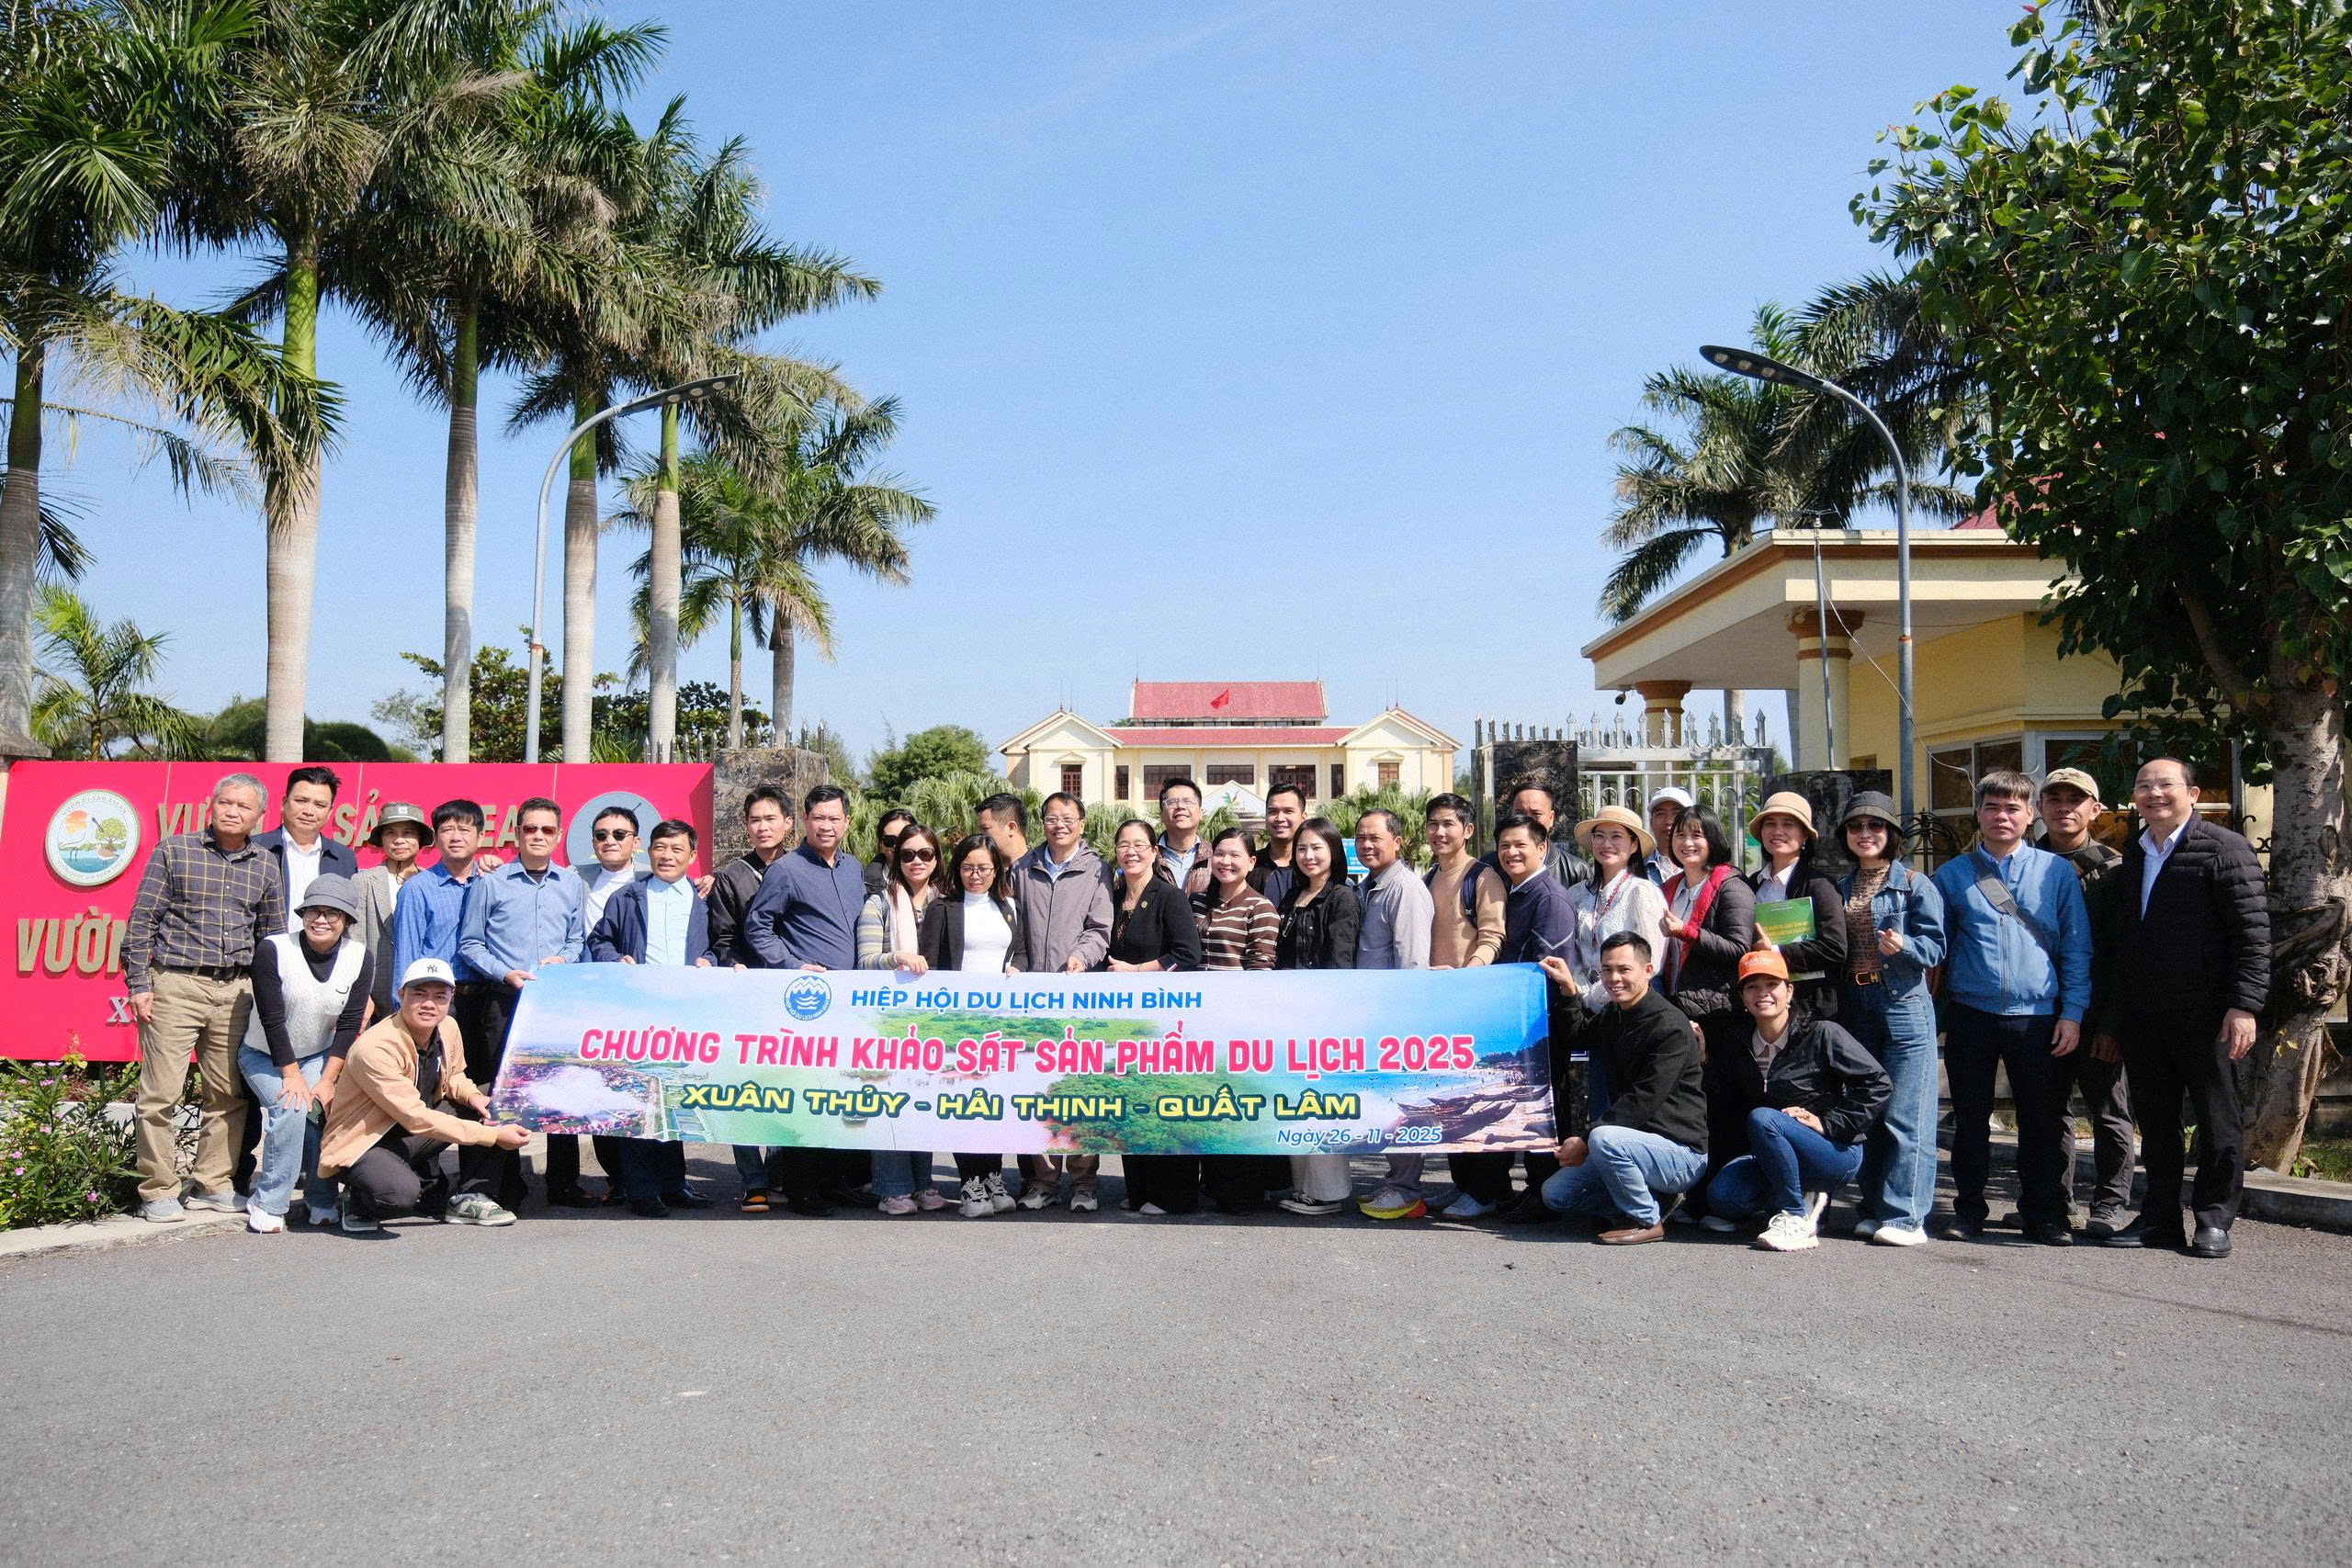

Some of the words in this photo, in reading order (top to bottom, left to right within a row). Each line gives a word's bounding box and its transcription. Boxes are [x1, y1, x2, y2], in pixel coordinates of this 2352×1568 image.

[852, 987, 908, 1010] HIỆP
[916, 987, 958, 1013] HỘI
[967, 992, 1001, 1009] DU
[1011, 992, 1064, 1013] LỊCH
[1073, 992, 1133, 1009] NINH
[1141, 987, 1202, 1009] BÌNH
[580, 1025, 720, 1064] CHƯƠNG
[735, 1027, 839, 1067] TRÌNH
[851, 1024, 944, 1071] KHẢO
[956, 1032, 1024, 1073] SÁT
[1035, 1026, 1103, 1073] SẢN
[1117, 1020, 1215, 1073] PHẨM
[1227, 1039, 1273, 1072] DU
[1287, 1037, 1364, 1079] LỊCH
[1378, 1035, 1475, 1070] 2025
[683, 1082, 791, 1111] XUÂN
[805, 1087, 905, 1114] THỦY
[938, 1089, 1001, 1117] HẢI
[1012, 1097, 1123, 1121] THỊNH
[1158, 1087, 1262, 1117] QUẤT
[1276, 1090, 1357, 1117] LÂM
[1277, 1129, 1327, 1145] Ngày
[1330, 1129, 1351, 1143] 26
[1368, 1128, 1381, 1143] 11
[1396, 1127, 1442, 1142] 2025
